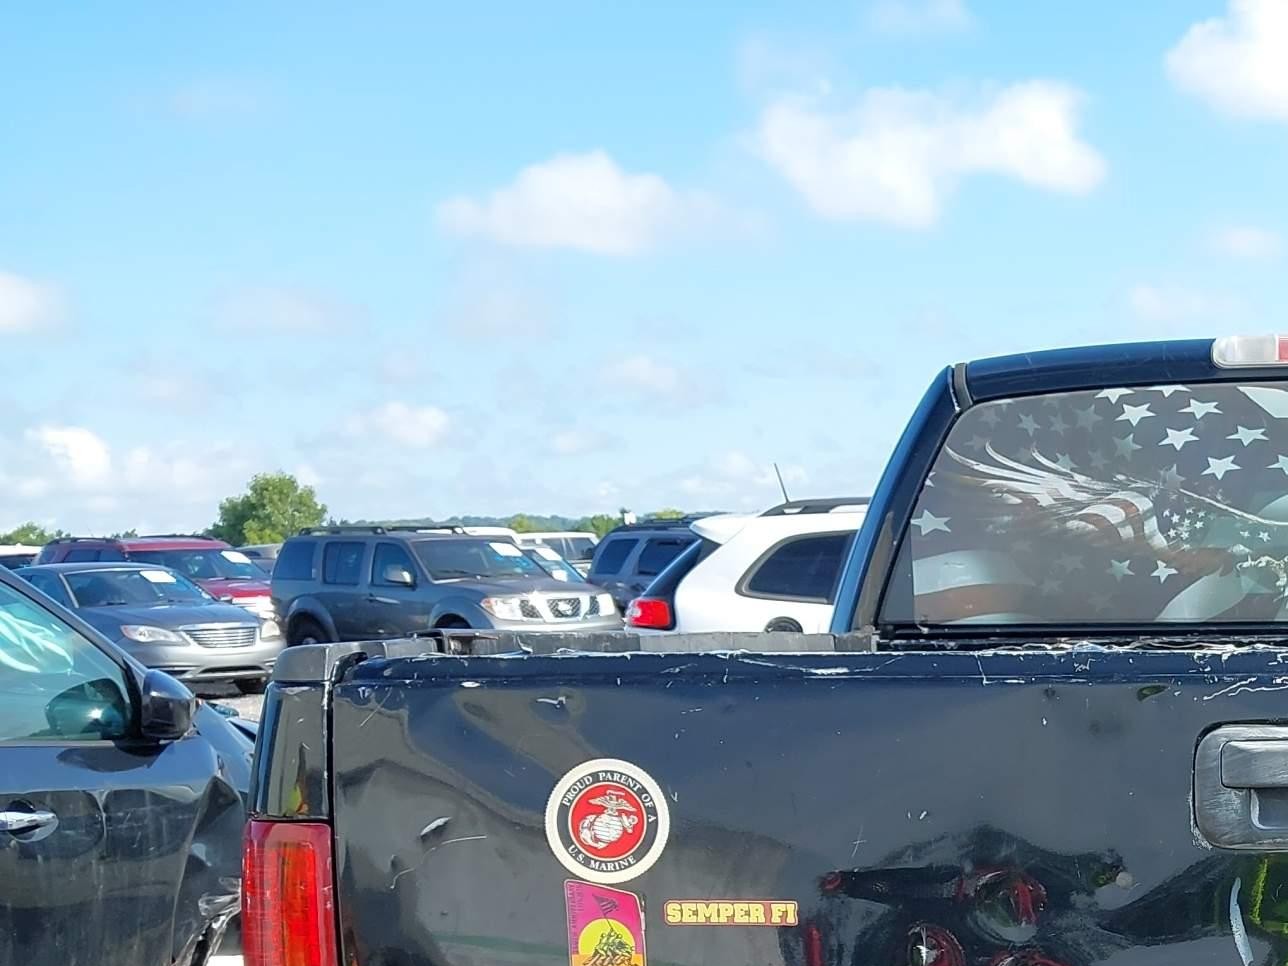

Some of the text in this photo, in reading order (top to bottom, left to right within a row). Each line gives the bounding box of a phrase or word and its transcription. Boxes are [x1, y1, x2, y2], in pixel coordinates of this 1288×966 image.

[562, 772, 657, 823] PROUD PARENT OF A
[589, 855, 637, 871] MARINE
[667, 903, 796, 923] SEMPER FI
